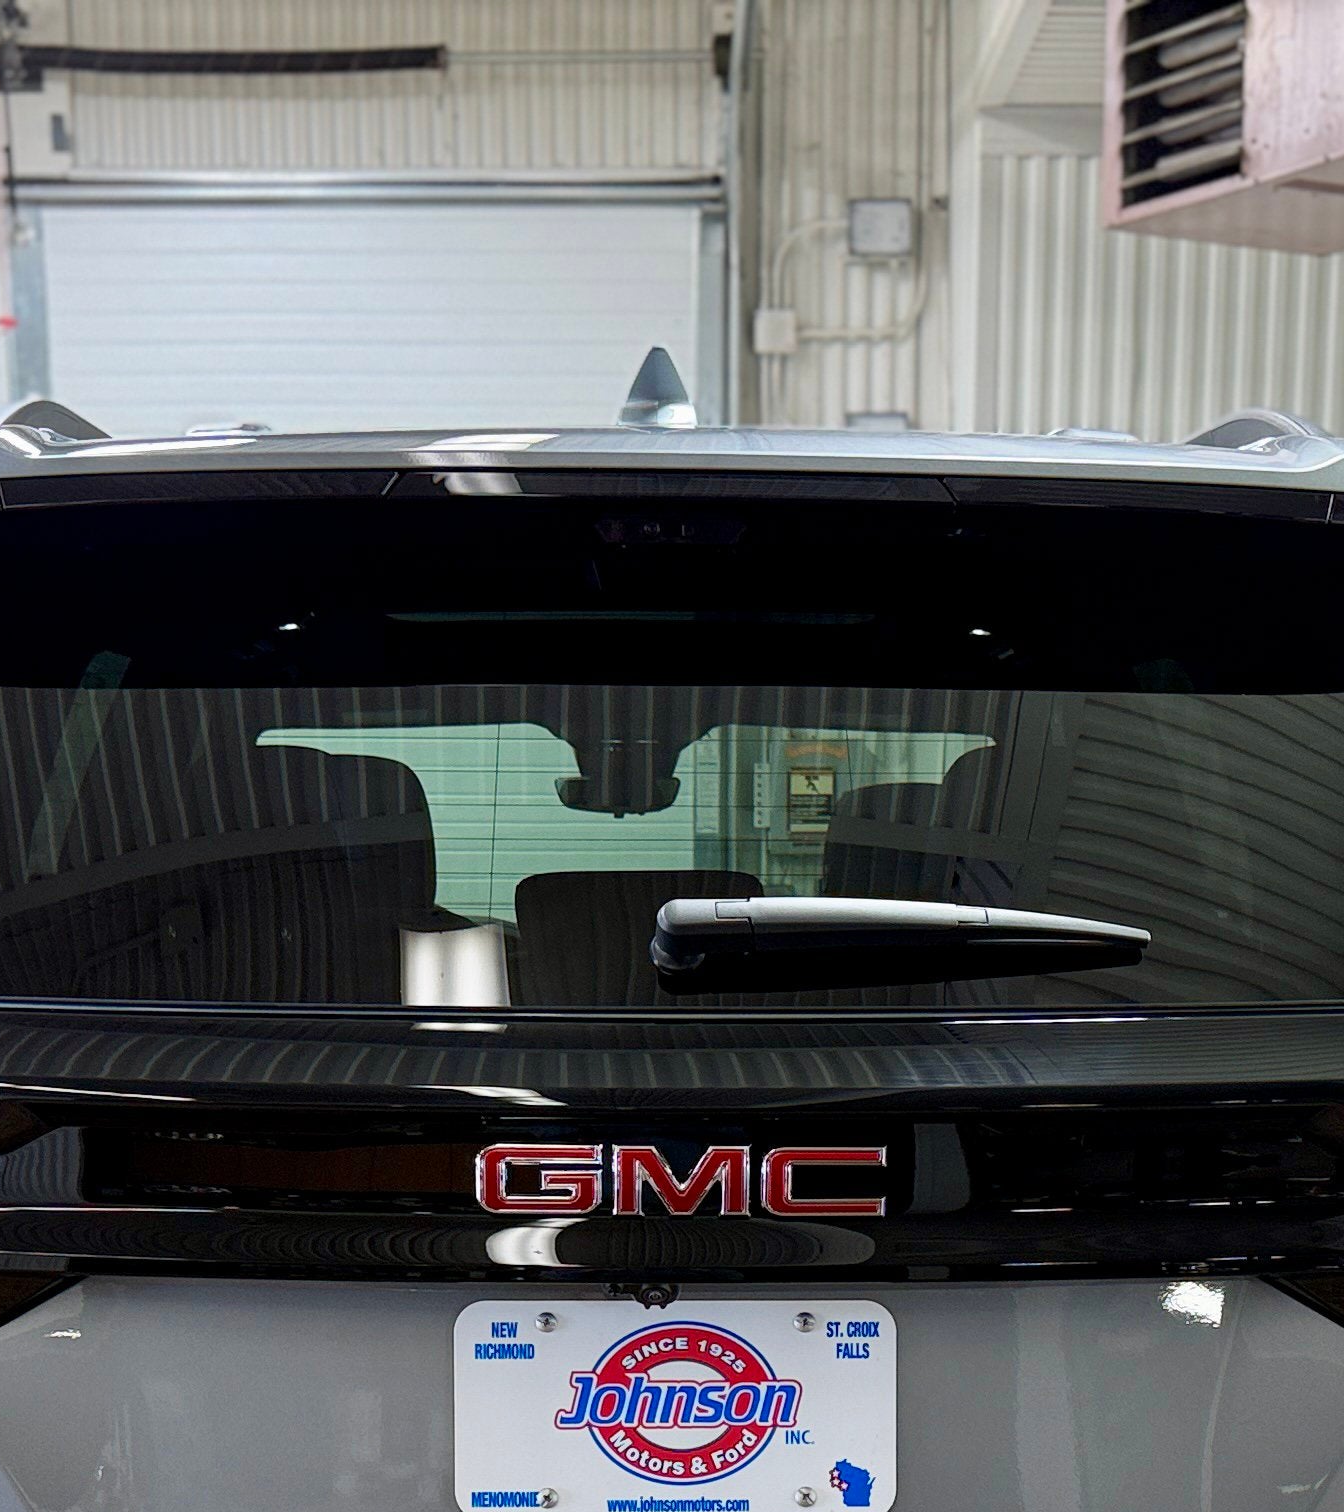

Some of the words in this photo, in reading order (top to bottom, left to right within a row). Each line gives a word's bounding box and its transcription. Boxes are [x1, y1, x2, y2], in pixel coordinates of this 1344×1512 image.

[475, 1143, 887, 1217] GMC
[491, 1322, 517, 1338] NEW
[826, 1321, 844, 1338] ST.
[847, 1321, 880, 1338] CROIX
[474, 1343, 535, 1360] RICHMOND
[620, 1336, 689, 1371] SINCE
[697, 1339, 747, 1374] 1925
[836, 1343, 870, 1359] FALLS
[558, 1375, 798, 1426] Johnson
[785, 1430, 815, 1445] INC.
[609, 1430, 685, 1476] Motors
[691, 1457, 708, 1475] &
[711, 1429, 758, 1470] Ford
